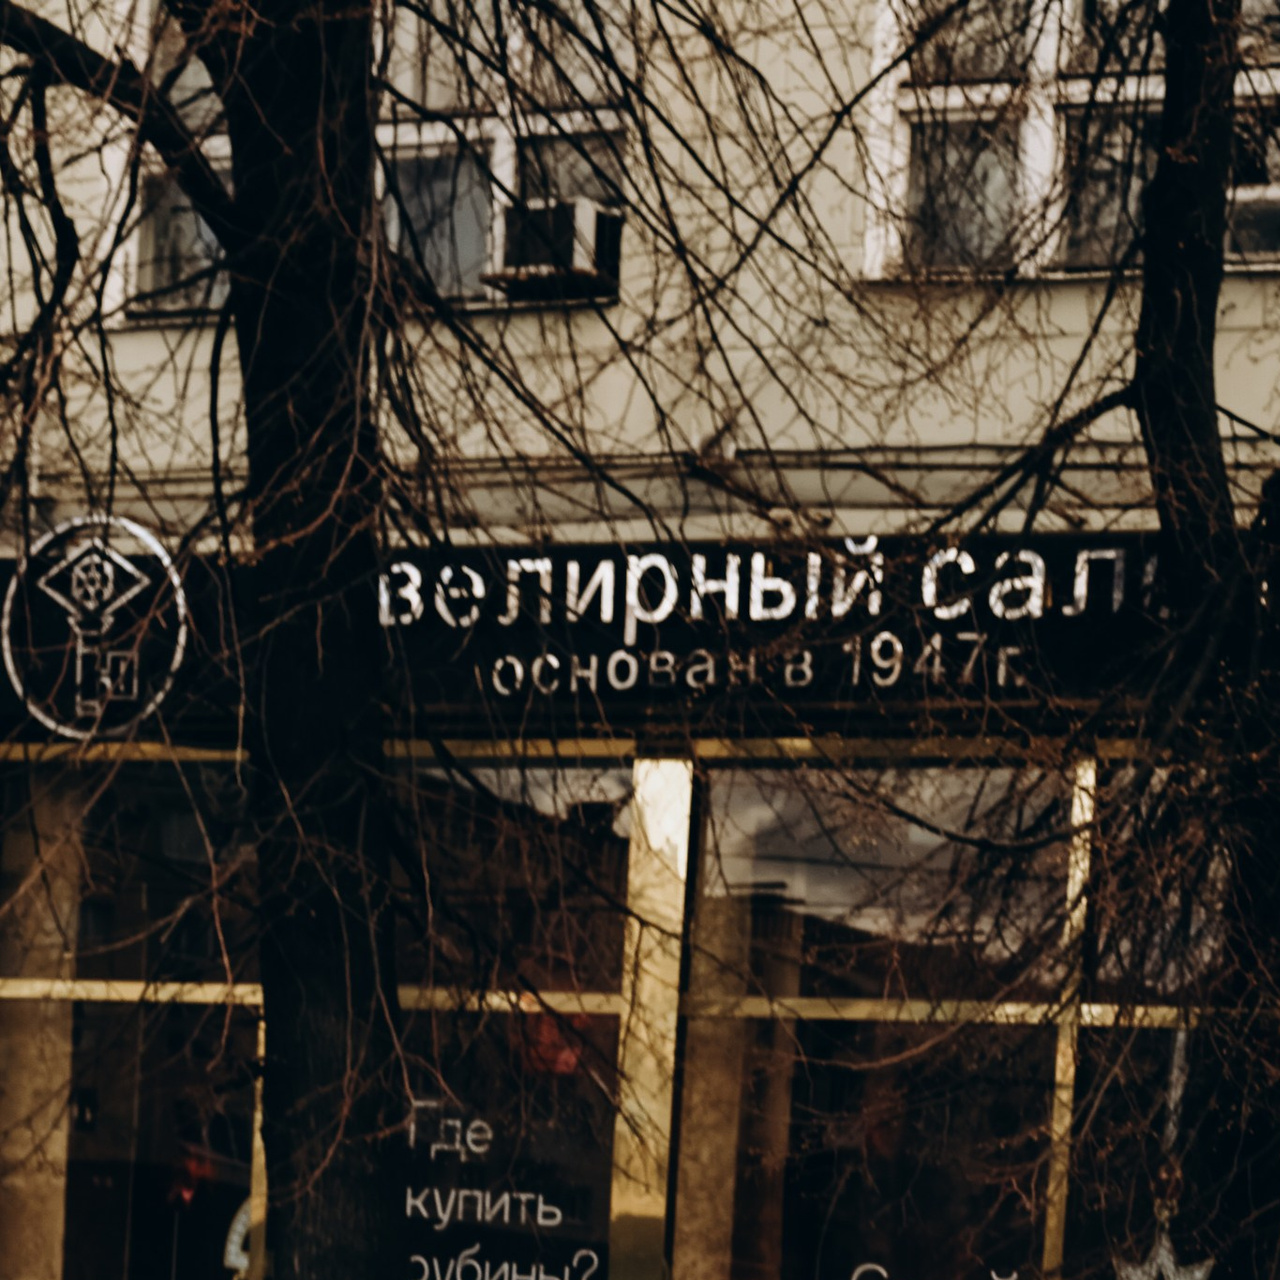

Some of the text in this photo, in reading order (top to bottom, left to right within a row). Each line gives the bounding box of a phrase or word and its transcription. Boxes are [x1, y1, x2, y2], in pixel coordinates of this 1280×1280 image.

[922, 545, 1172, 621] сал
[491, 650, 756, 694] основан
[784, 652, 813, 689] в
[409, 1100, 493, 1161] Где
[406, 1187, 563, 1231] купить
